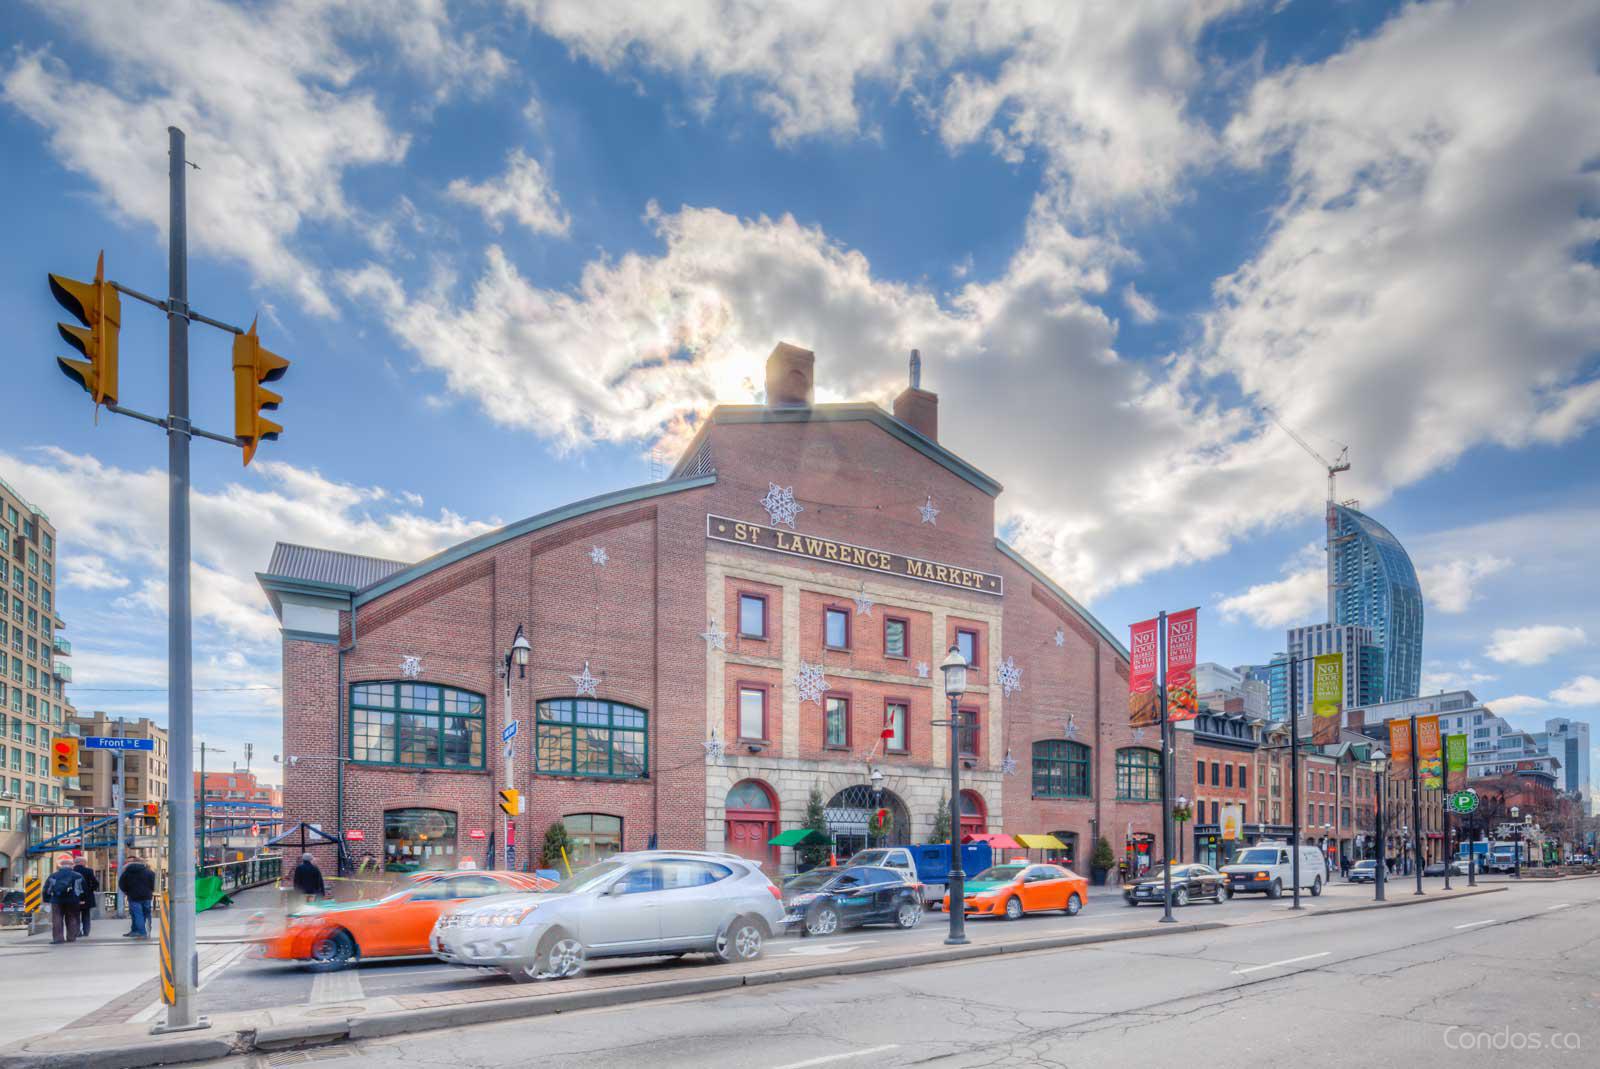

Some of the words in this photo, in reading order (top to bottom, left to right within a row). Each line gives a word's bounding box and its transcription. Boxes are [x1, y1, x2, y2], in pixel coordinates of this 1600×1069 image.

[776, 532, 892, 571] LAWRENCE
[906, 559, 984, 588] MARKET
[1171, 634, 1193, 643] FOOD
[1134, 643, 1154, 653] FOOD
[99, 738, 124, 747] Front
[134, 740, 140, 748] E
[1458, 796, 1470, 806] P
